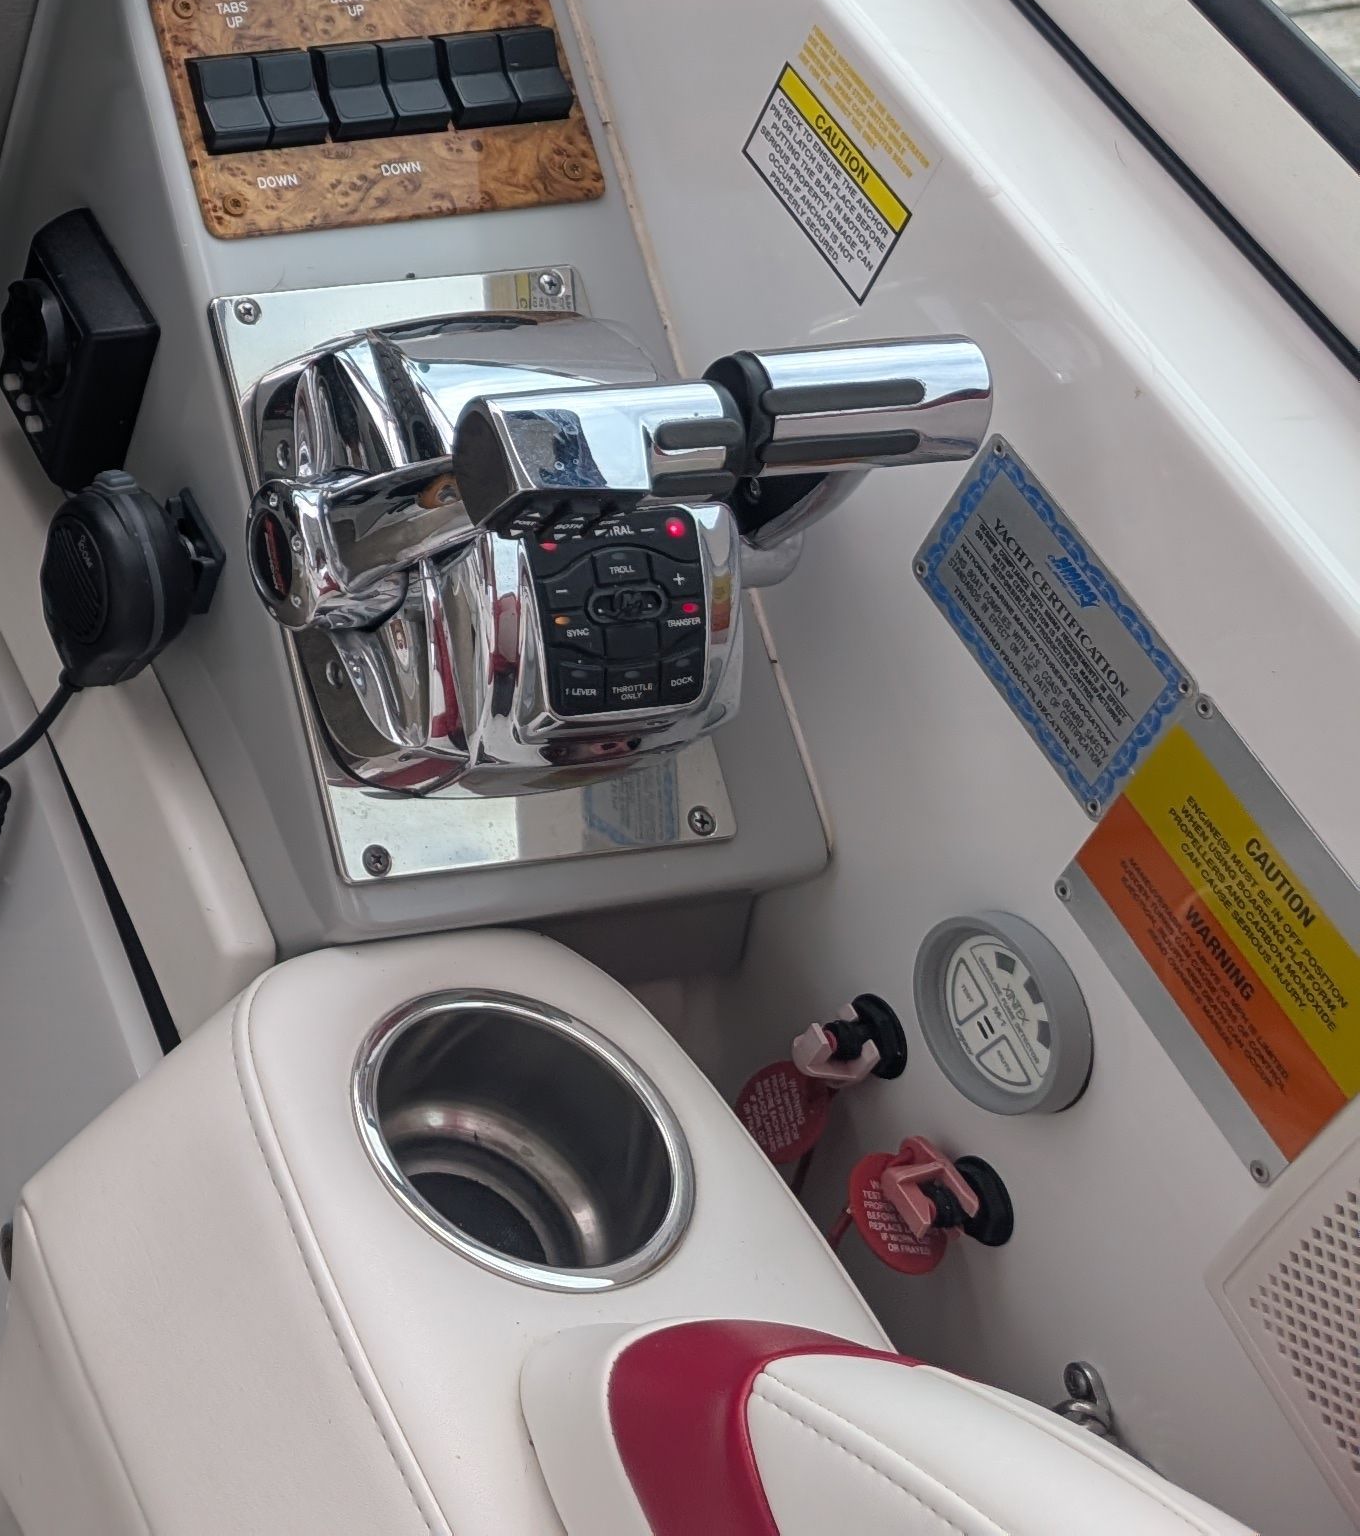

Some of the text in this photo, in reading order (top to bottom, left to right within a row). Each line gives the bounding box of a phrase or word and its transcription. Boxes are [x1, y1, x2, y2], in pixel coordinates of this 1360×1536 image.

[215, 0, 248, 16] TABS
[226, 15, 244, 29] UP
[347, 4, 365, 18] UP
[256, 173, 298, 191] DOWN
[381, 160, 422, 177] DOWN
[768, 102, 886, 254] PIN OR LATCH IS IN PLACE BEFORE
[770, 120, 873, 254] PUTTING THE BOAT IN MOTION.
[777, 96, 889, 239] CHECK TO ENSURE THE ANCHOR
[813, 111, 870, 185] CAUTION
[759, 123, 874, 273] SERIOUS PROPERTY DAMAGE CAN
[767, 150, 854, 265] OCCUR IF ANCHOR IS NOT
[769, 169, 840, 265] PROPERLY SECURED.
[609, 565, 636, 574] TROLL
[991, 517, 1034, 574] YACHT
[1029, 567, 1130, 699] CERTIFICATION
[566, 628, 590, 638] SYNC
[667, 616, 702, 628] TRANSFER
[946, 556, 1103, 769] STANDARDS IN EFFECT ON THE DATE OF CERTIFICATION
[951, 548, 1110, 762] THIS BOAT COMPLIES WITH U.S. COAST GUARD SAFETY
[958, 541, 1112, 747] NATIONAL MARINE MANUFACTURERS ASSOCIATION
[571, 688, 597, 696] LEVER
[612, 682, 653, 693] THROTTLE
[621, 692, 643, 701] ONLY
[670, 675, 694, 687] DOCK
[951, 583, 1081, 760] THUNDERBIRD IN
[1179, 803, 1285, 946] WHEN USING BOARDING
[1185, 793, 1348, 1011] ENGINE(S) MUST BE IN OFF POSITION
[1242, 833, 1316, 932] CAUTION
[1167, 805, 1337, 1034] PROPELLERS AND CARBON MONOXIDE
[1179, 840, 1307, 1013] CAN CAUSE SERIOUS INJURY.
[1183, 903, 1256, 1004] WARNING
[1000, 982, 1031, 1026] XINTEX
[1190, 957, 1250, 1040] CAUSE OF
[788, 1078, 806, 1125] WARNING
[887, 1243, 899, 1252] OR
